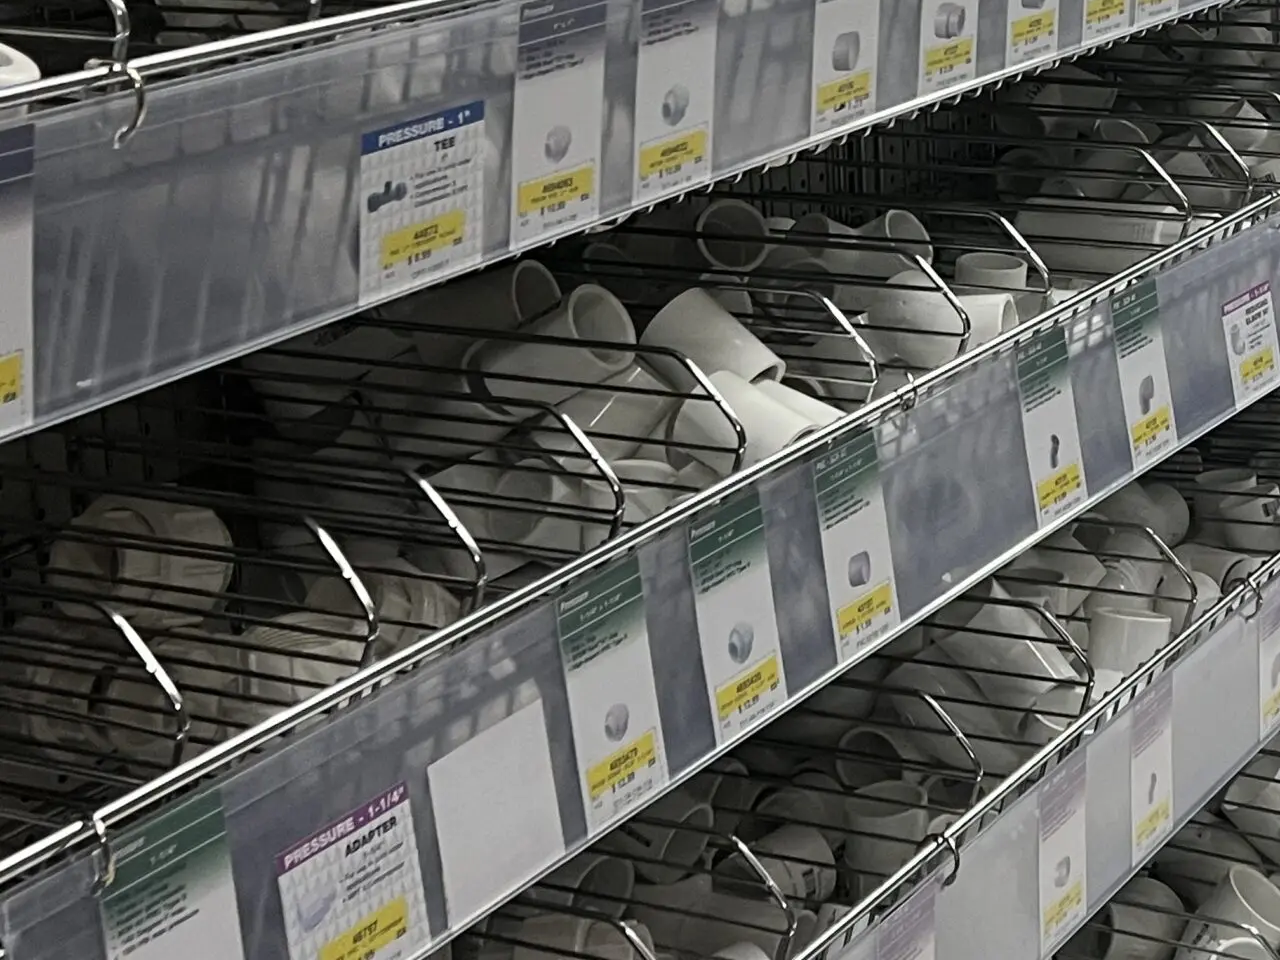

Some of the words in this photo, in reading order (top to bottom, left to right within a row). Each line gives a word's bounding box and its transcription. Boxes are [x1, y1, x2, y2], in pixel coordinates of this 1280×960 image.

[378, 117, 445, 147] PRESSURE
[458, 109, 471, 125] 1"
[433, 136, 456, 152] TEE
[284, 817, 355, 870] PRESSURE
[368, 786, 404, 818] 1-1/4"
[345, 816, 397, 858] ADAPTER
